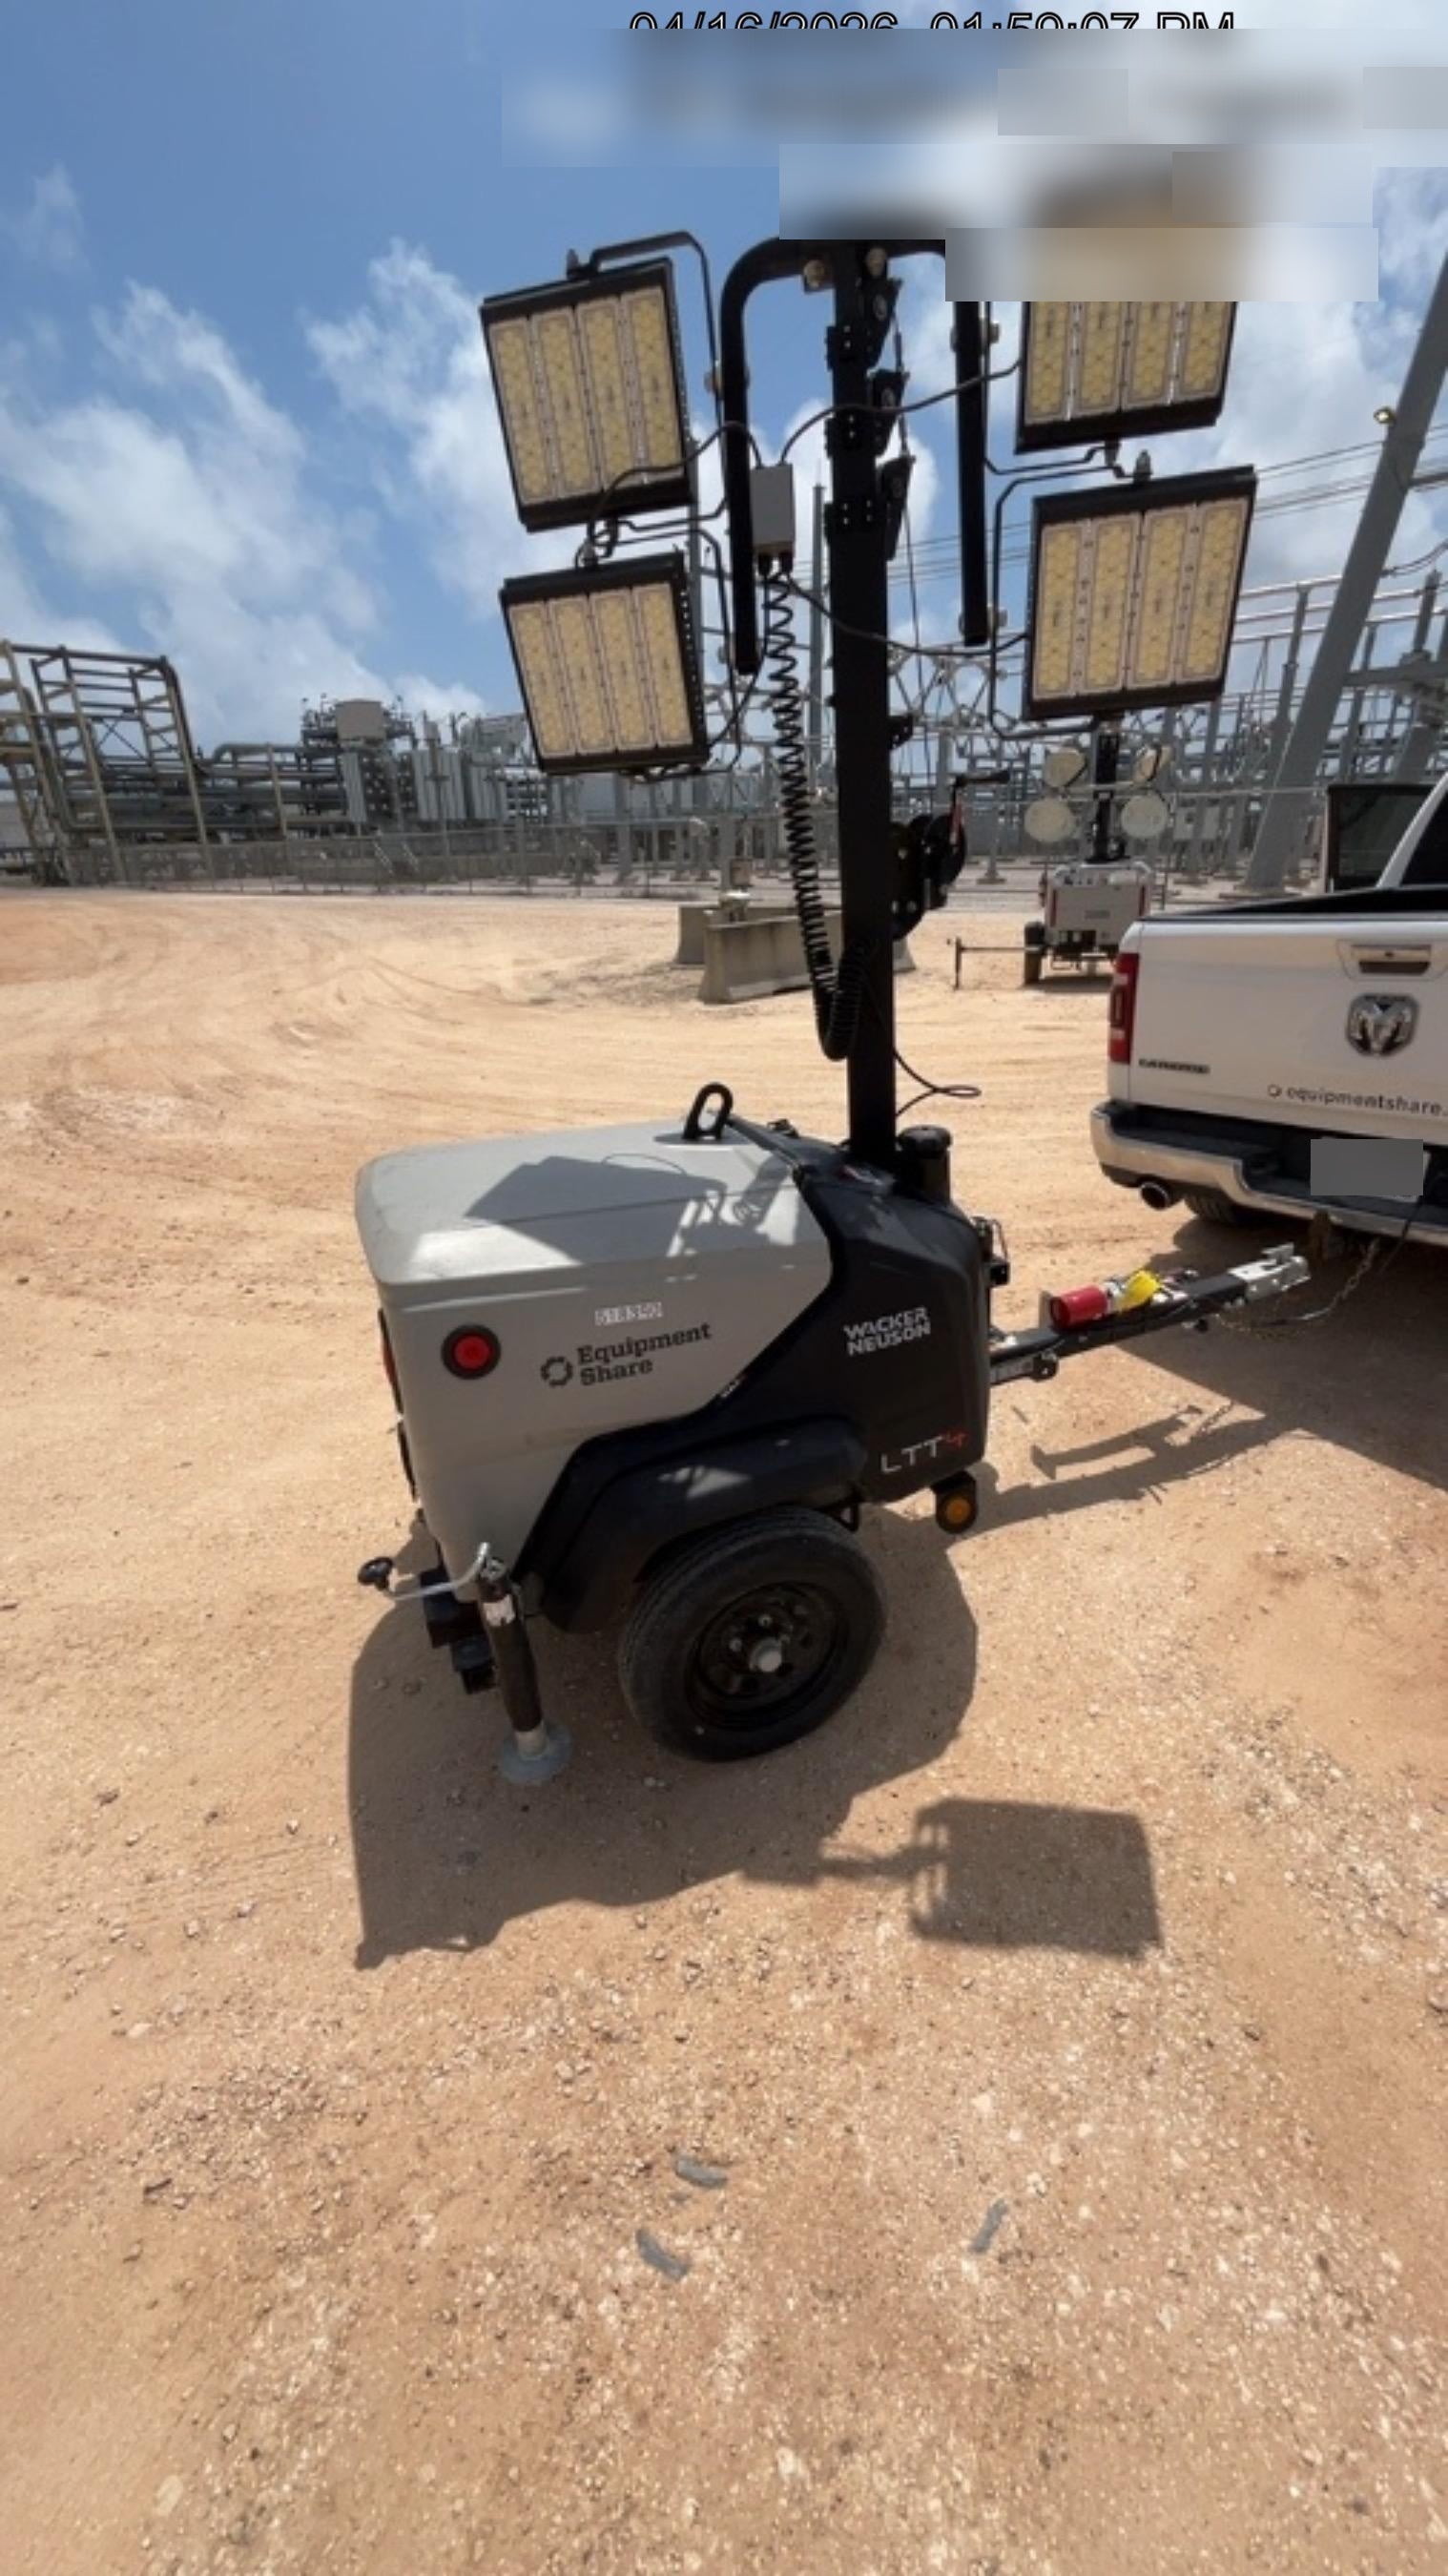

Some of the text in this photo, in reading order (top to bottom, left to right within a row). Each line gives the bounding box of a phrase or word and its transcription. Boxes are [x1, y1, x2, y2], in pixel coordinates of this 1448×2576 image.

[843, 1306, 929, 1340] WACKER
[847, 1321, 932, 1355] NEUSON
[577, 1322, 712, 1365] Equipment
[579, 1359, 653, 1385] Share
